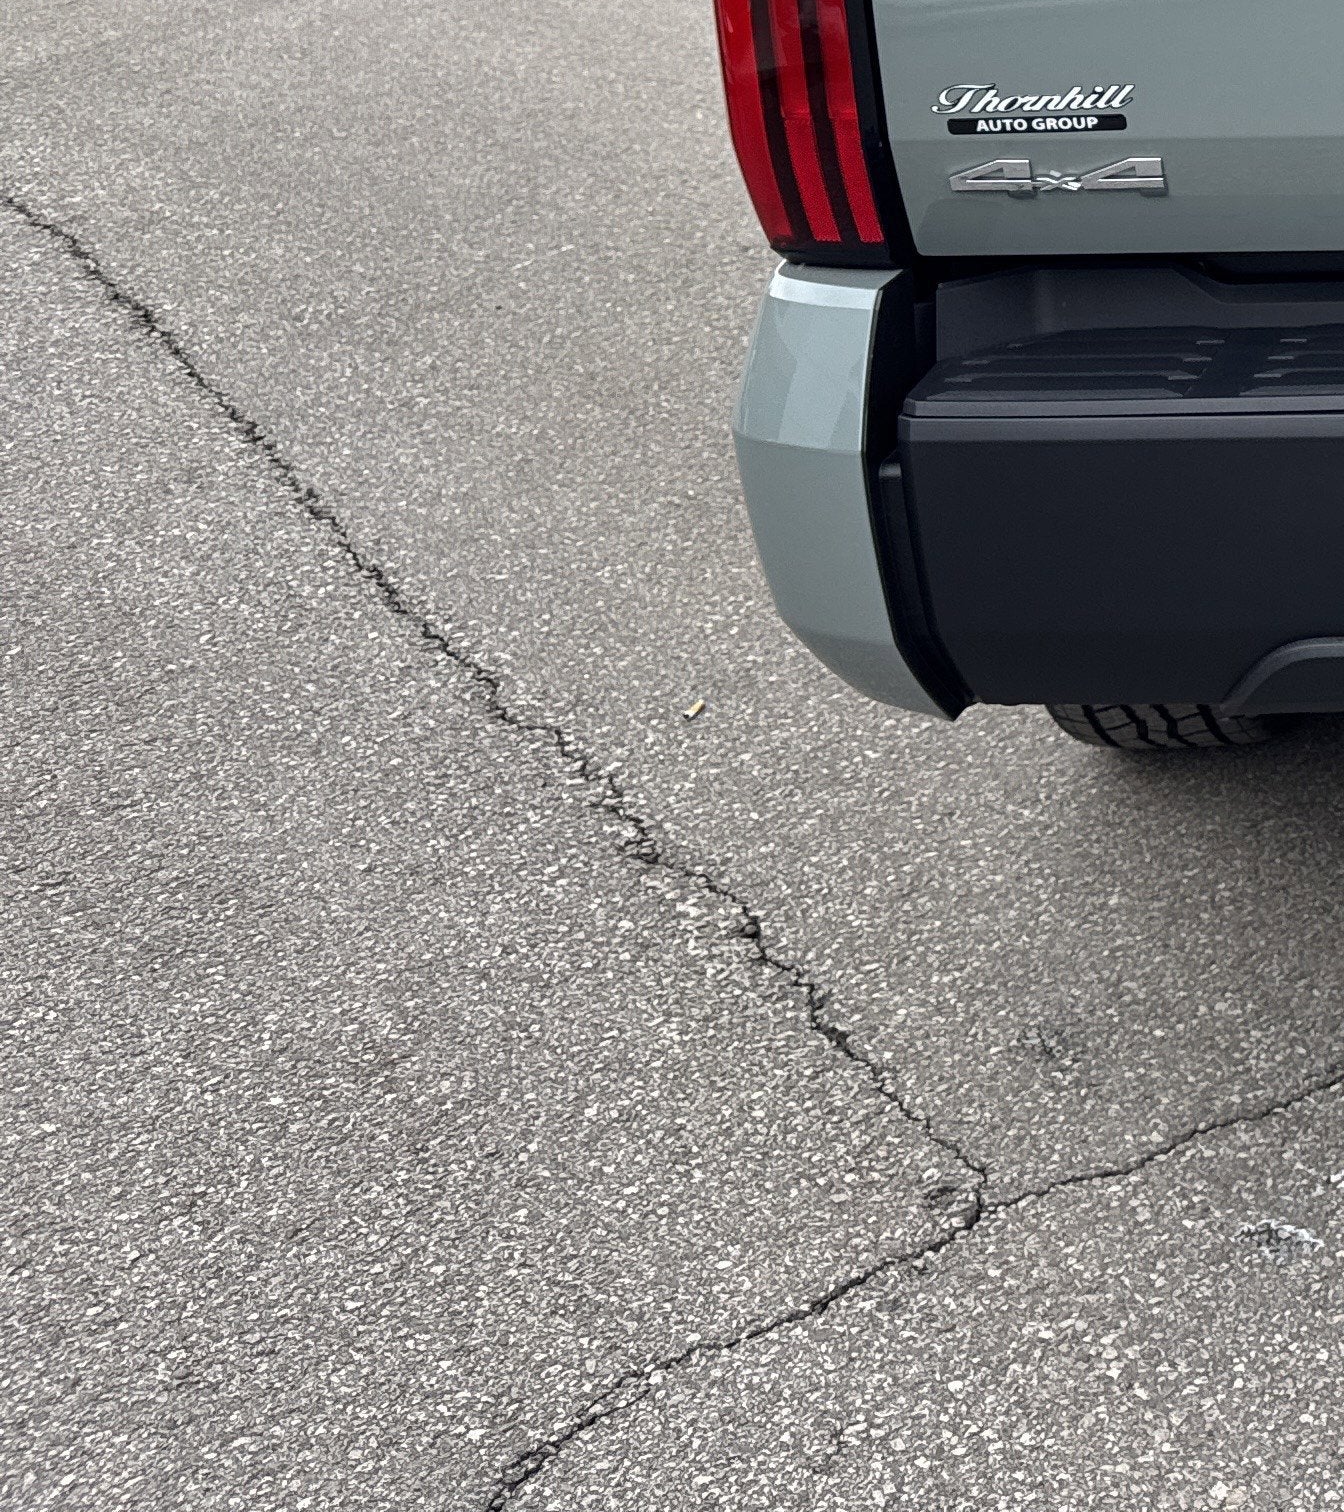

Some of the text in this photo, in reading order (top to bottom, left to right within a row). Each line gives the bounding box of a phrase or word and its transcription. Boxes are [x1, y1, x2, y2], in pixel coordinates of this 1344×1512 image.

[931, 83, 1135, 114] Thornhill
[975, 116, 1099, 133] AUTO GROUP
